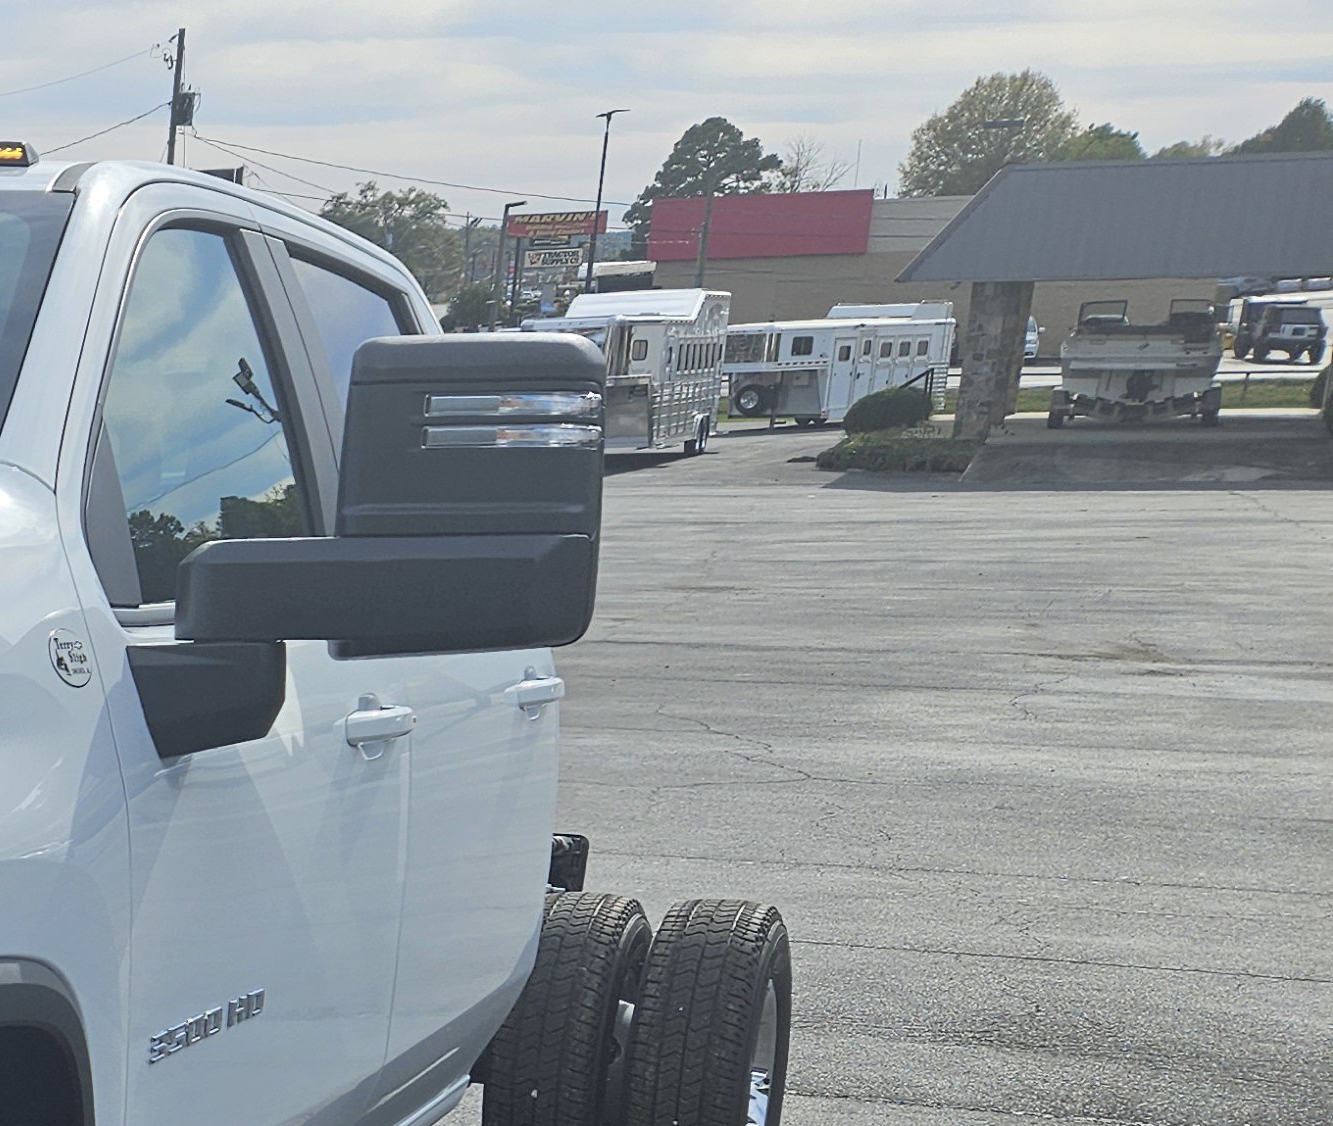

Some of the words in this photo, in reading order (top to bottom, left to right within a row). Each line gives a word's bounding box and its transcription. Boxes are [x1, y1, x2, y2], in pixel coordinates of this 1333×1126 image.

[543, 250, 580, 259] TRACTOR
[541, 258, 569, 266] SUPPLY
[149, 1005, 223, 1065] 3500
[226, 988, 265, 1029] HD
